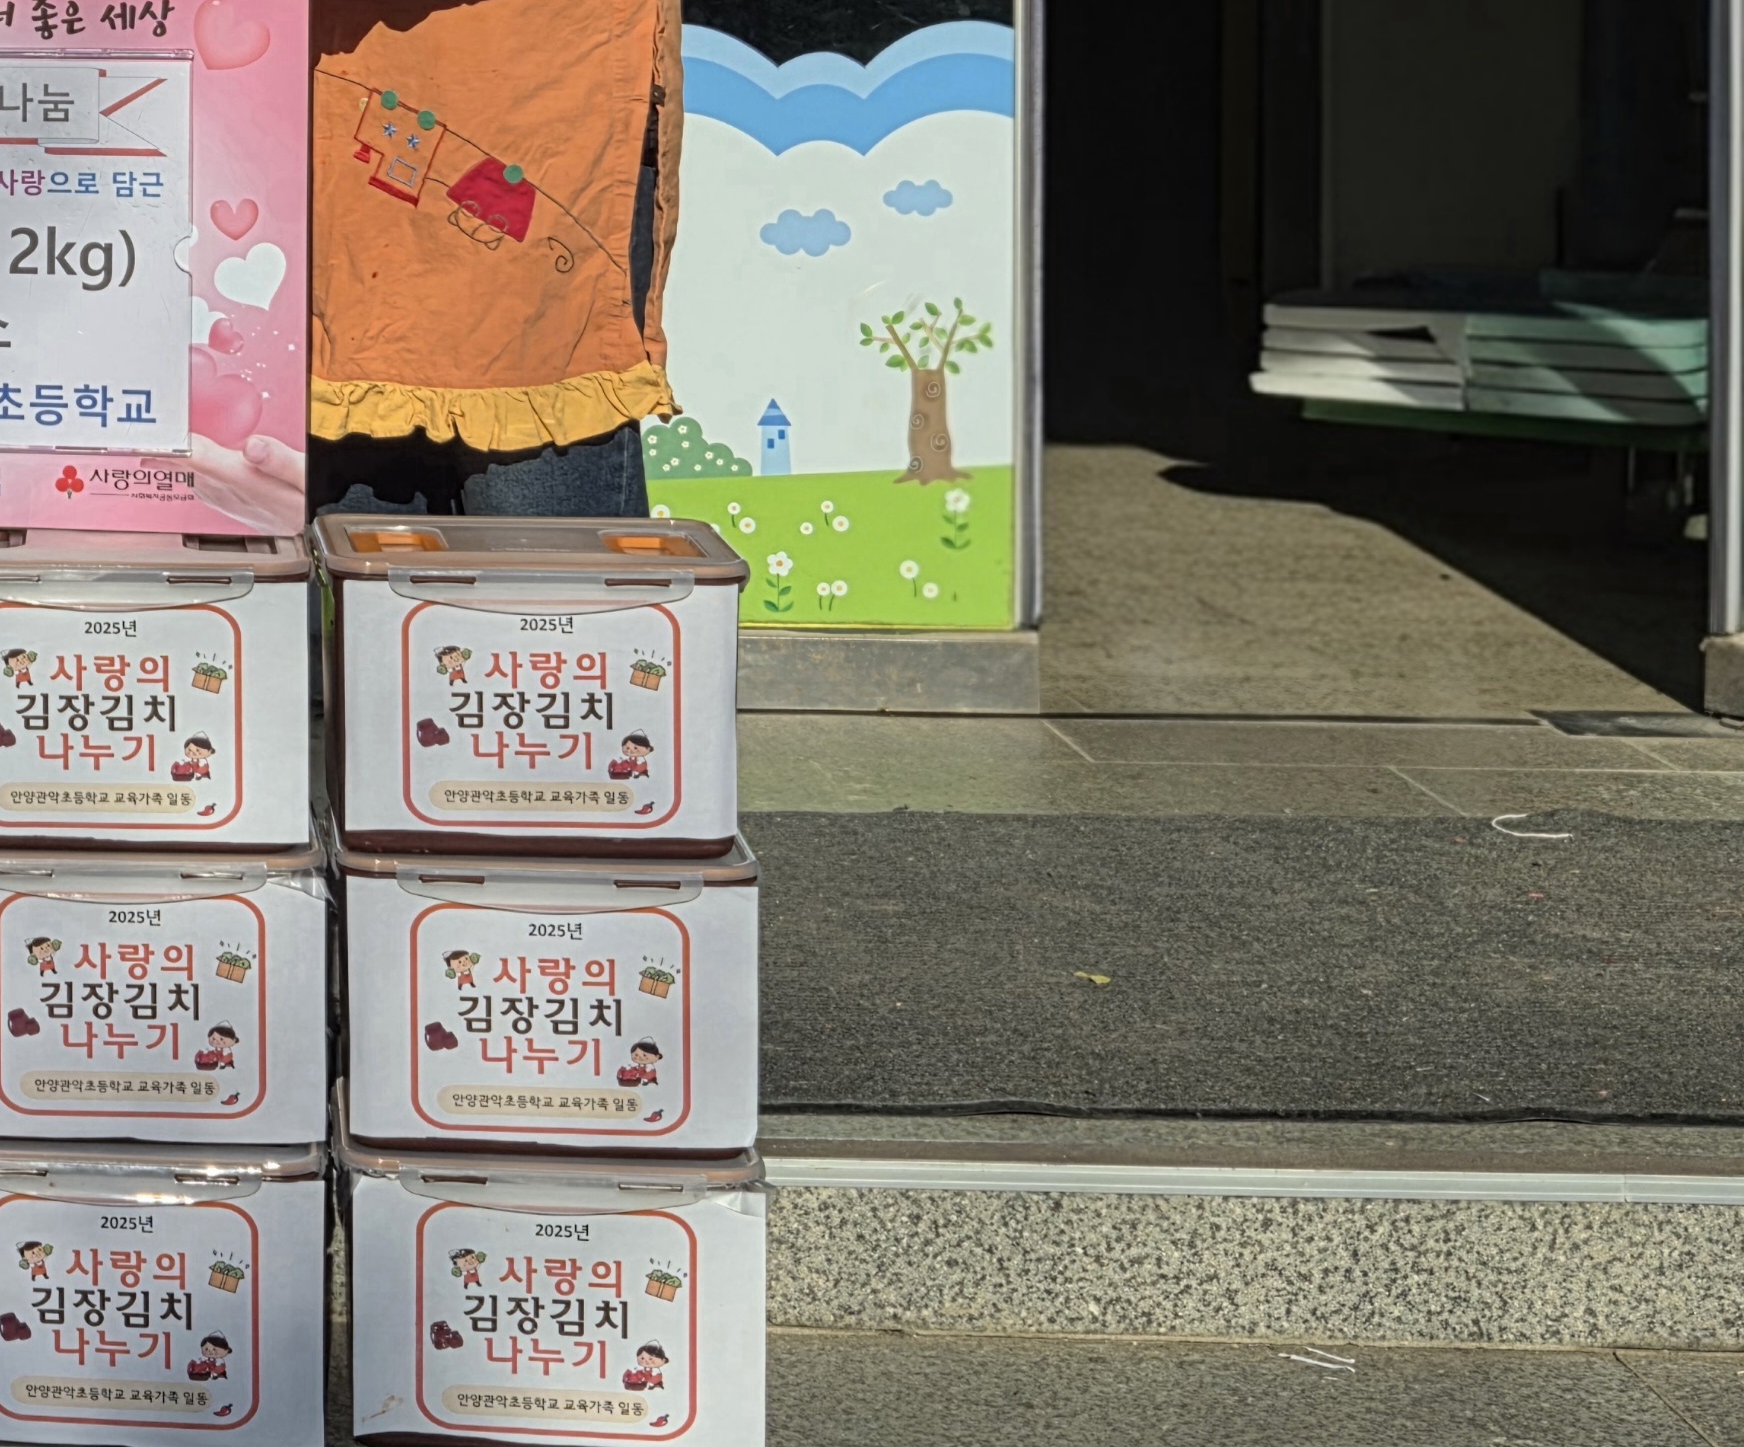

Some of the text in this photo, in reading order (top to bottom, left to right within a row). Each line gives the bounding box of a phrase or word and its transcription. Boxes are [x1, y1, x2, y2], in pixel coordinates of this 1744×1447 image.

[100, 0, 175, 37] 세상
[112, 171, 164, 199] 담근
[89, 469, 195, 492] 사랑의열매
[83, 619, 138, 638] 2025년
[519, 616, 574, 634] 2025년
[49, 653, 170, 693] 사랑의
[484, 650, 608, 691] 사랑의
[15, 692, 177, 733] 김장김치
[449, 690, 614, 731] 김장김치
[36, 732, 156, 772] 나누기
[470, 730, 593, 771] 나누기
[10, 789, 192, 807] 안양관악초등학교 교육가족 일동
[444, 788, 630, 806] 안양관악초등학교 교육가족 일동
[108, 908, 162, 926] 2025년
[527, 921, 583, 940] 2025년
[73, 941, 194, 982] 사랑의
[492, 955, 616, 997] 사랑의
[39, 980, 201, 1022] 김장김치
[457, 994, 623, 1037] 김장김치
[60, 1020, 180, 1061] 나누기
[478, 1035, 602, 1077] 나누기
[34, 1077, 216, 1096] 안양관악초등학교 교육가족 일동
[452, 1092, 639, 1113] 안양관악초등학교 교육가족 일동
[100, 1213, 154, 1233] 2025년
[534, 1221, 590, 1241] 2025년
[65, 1247, 187, 1291] 사랑의
[498, 1254, 623, 1299] 사랑의
[31, 1285, 193, 1331] 김장김치
[463, 1293, 629, 1340] 김장김치
[51, 1326, 172, 1370] 나누기
[483, 1335, 608, 1380] 나누기
[25, 1383, 209, 1407] 안양관악초등학교 교육가족 일동
[457, 1392, 645, 1417] 안양관악초등학교 교육가족 일동
